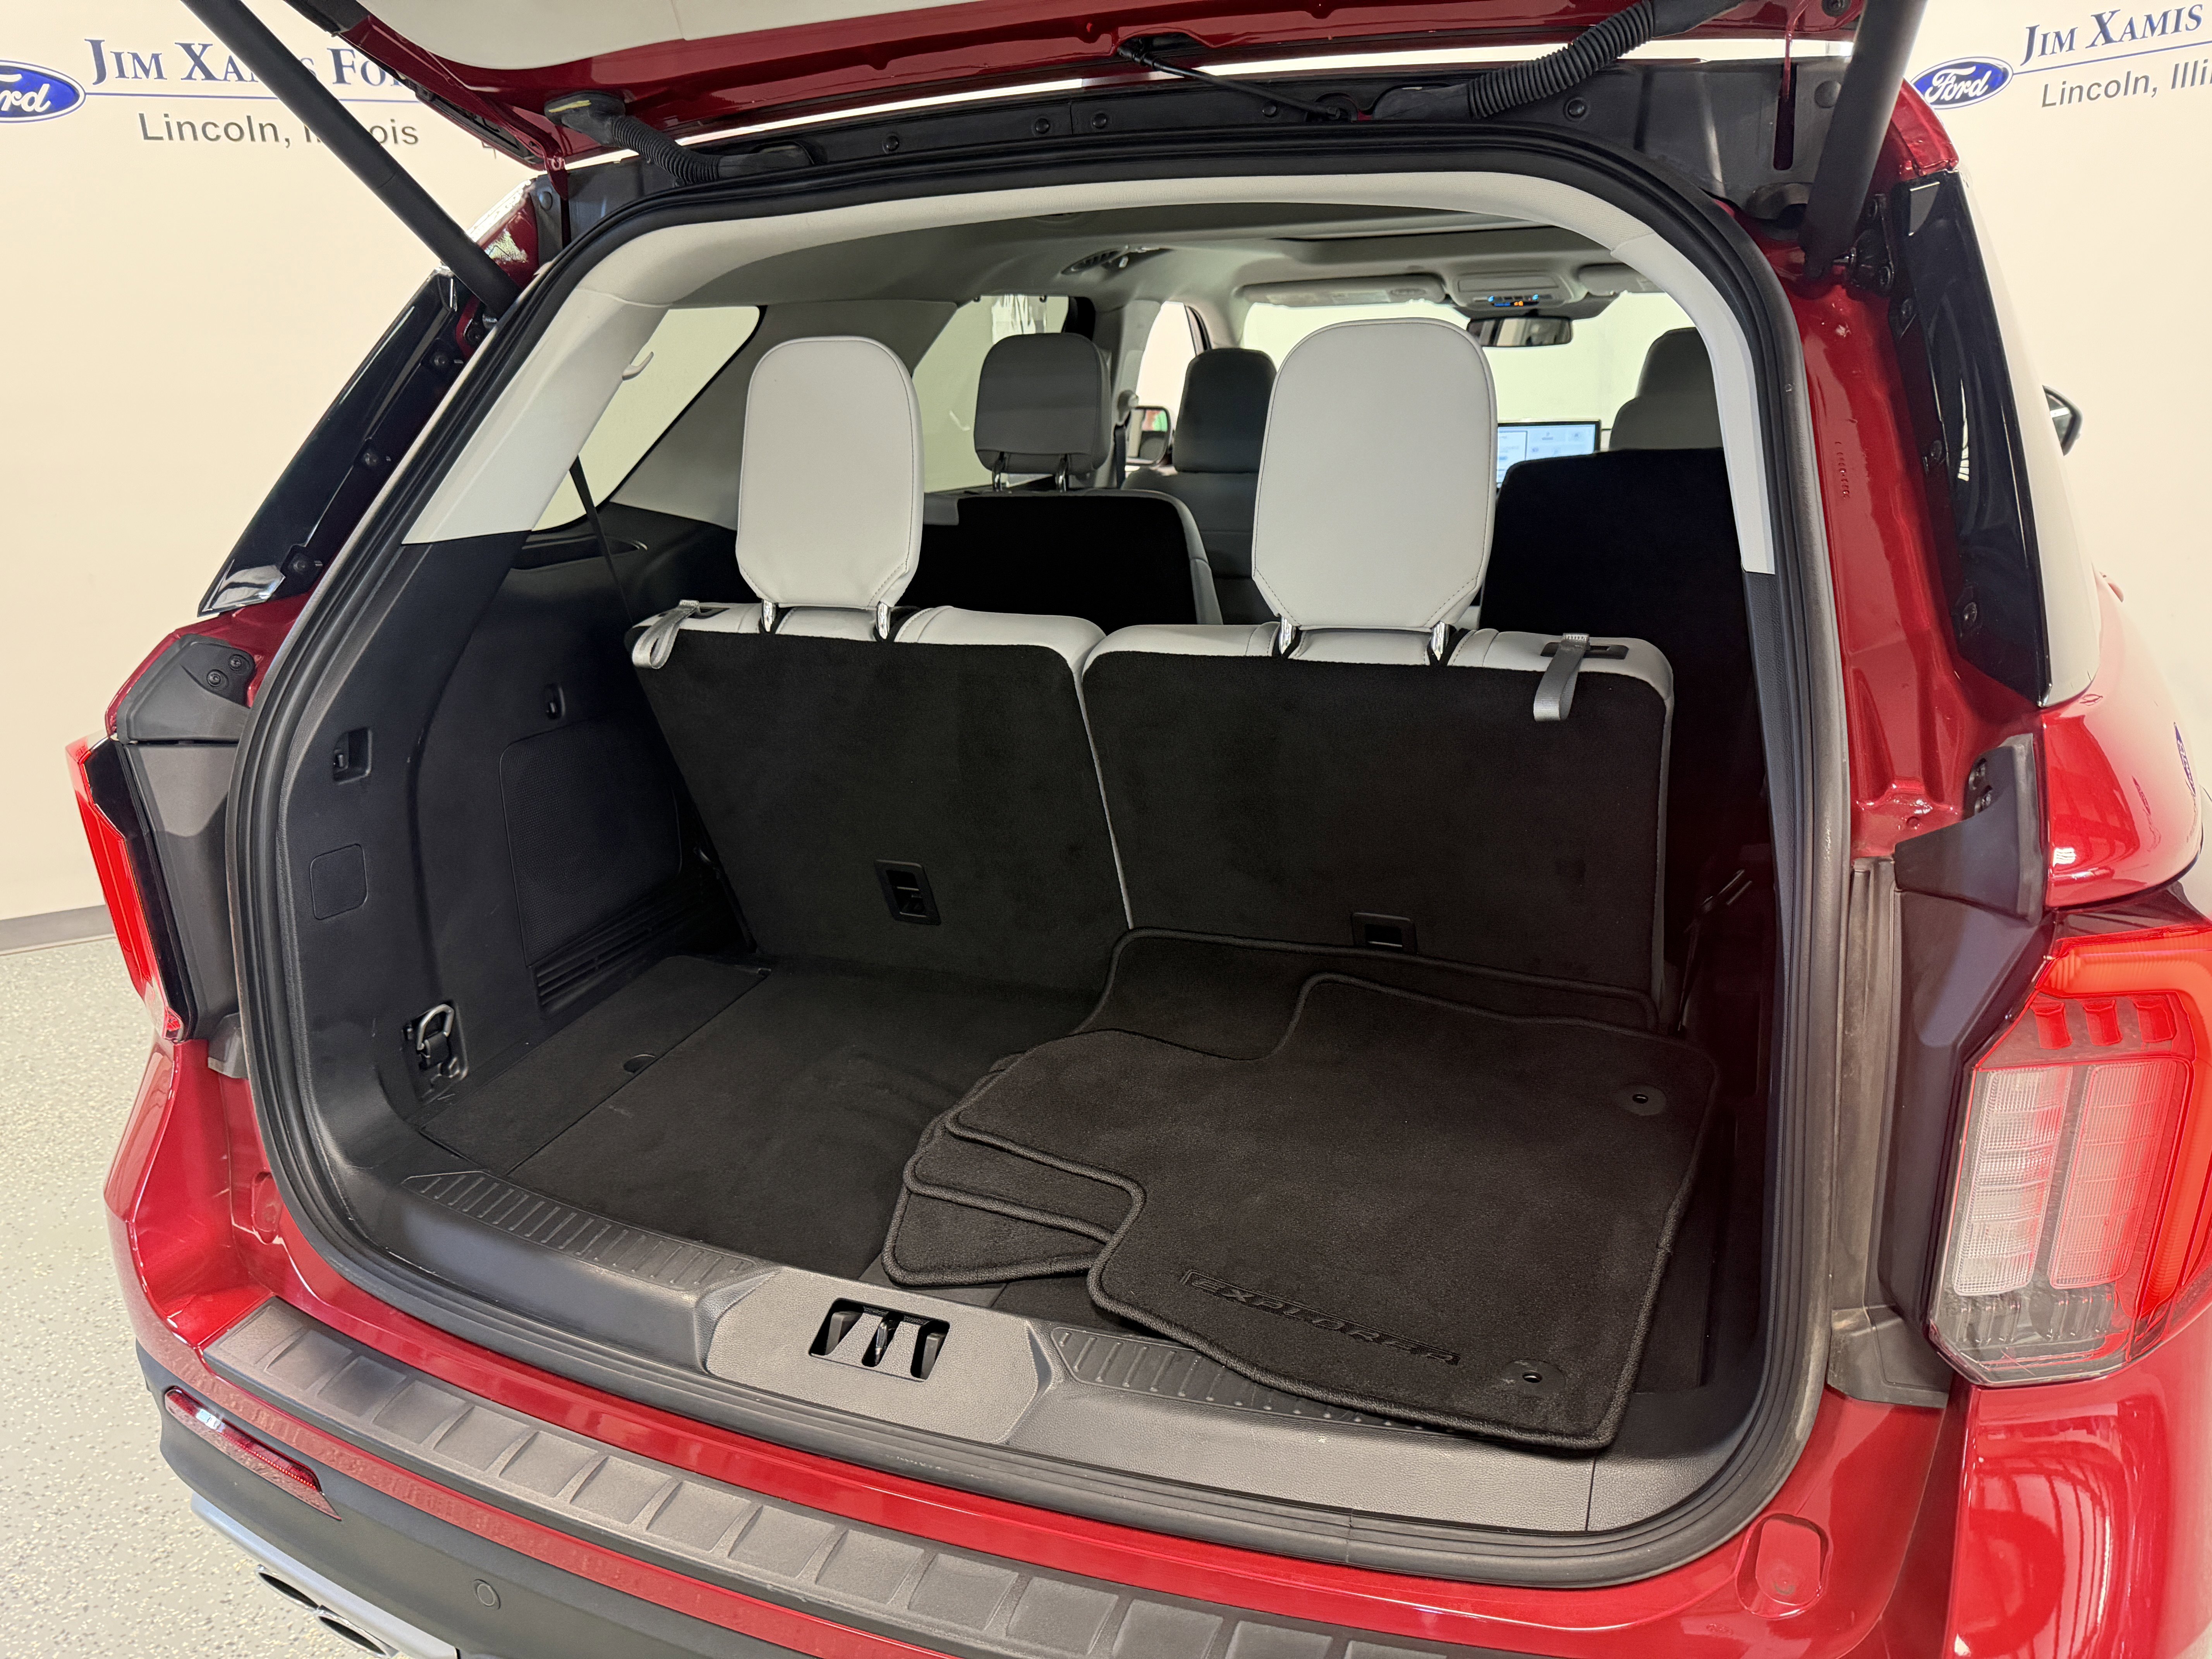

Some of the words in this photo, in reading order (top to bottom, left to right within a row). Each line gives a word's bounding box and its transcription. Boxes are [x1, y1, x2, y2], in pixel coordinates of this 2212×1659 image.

[2020, 24, 2078, 66] JIM
[2085, 4, 2203, 48] XAMIS
[84, 38, 167, 85] JIM
[1924, 65, 1992, 104] Ford
[2042, 70, 2157, 108] Lincoln,
[2171, 58, 2212, 89] Illi
[0, 74, 51, 112] rd
[139, 113, 290, 149] Lincoln,
[1189, 1275, 1455, 1364] EXPLORER
